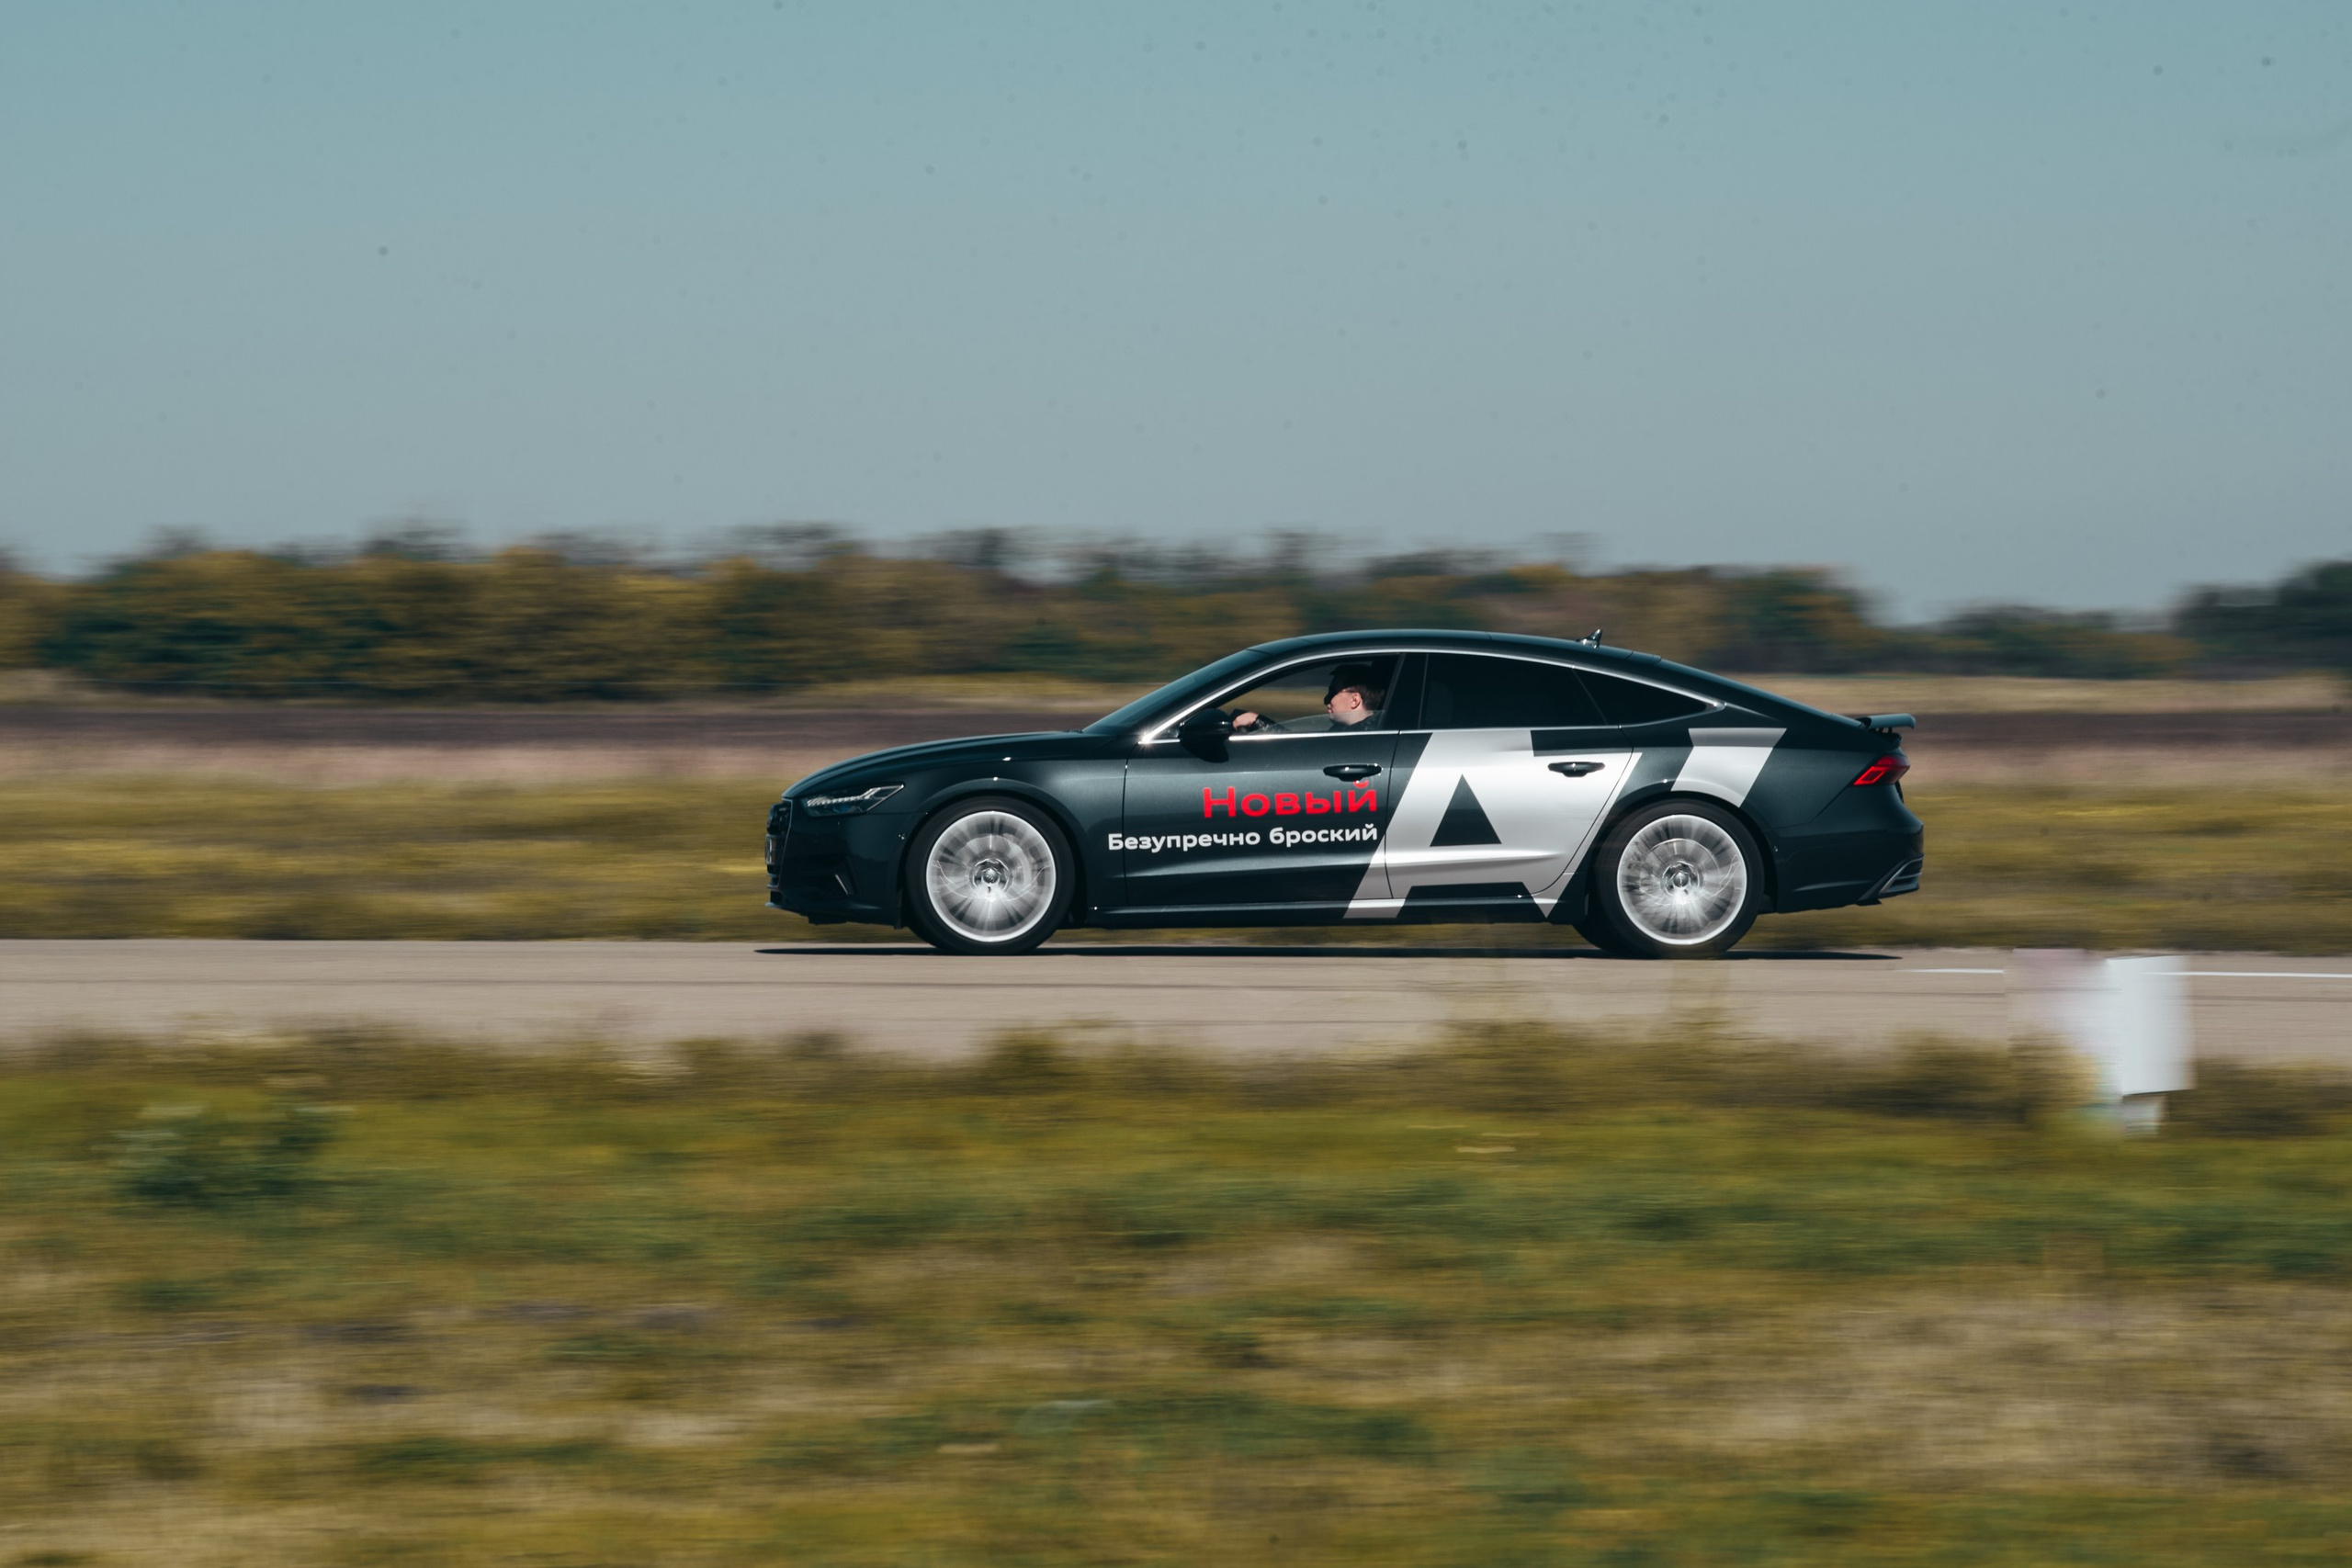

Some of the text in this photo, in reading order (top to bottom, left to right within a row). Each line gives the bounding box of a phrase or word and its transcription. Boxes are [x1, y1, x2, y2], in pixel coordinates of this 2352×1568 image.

[1203, 780, 1378, 818] Новый
[1108, 823, 1378, 853] Безупречно броский
